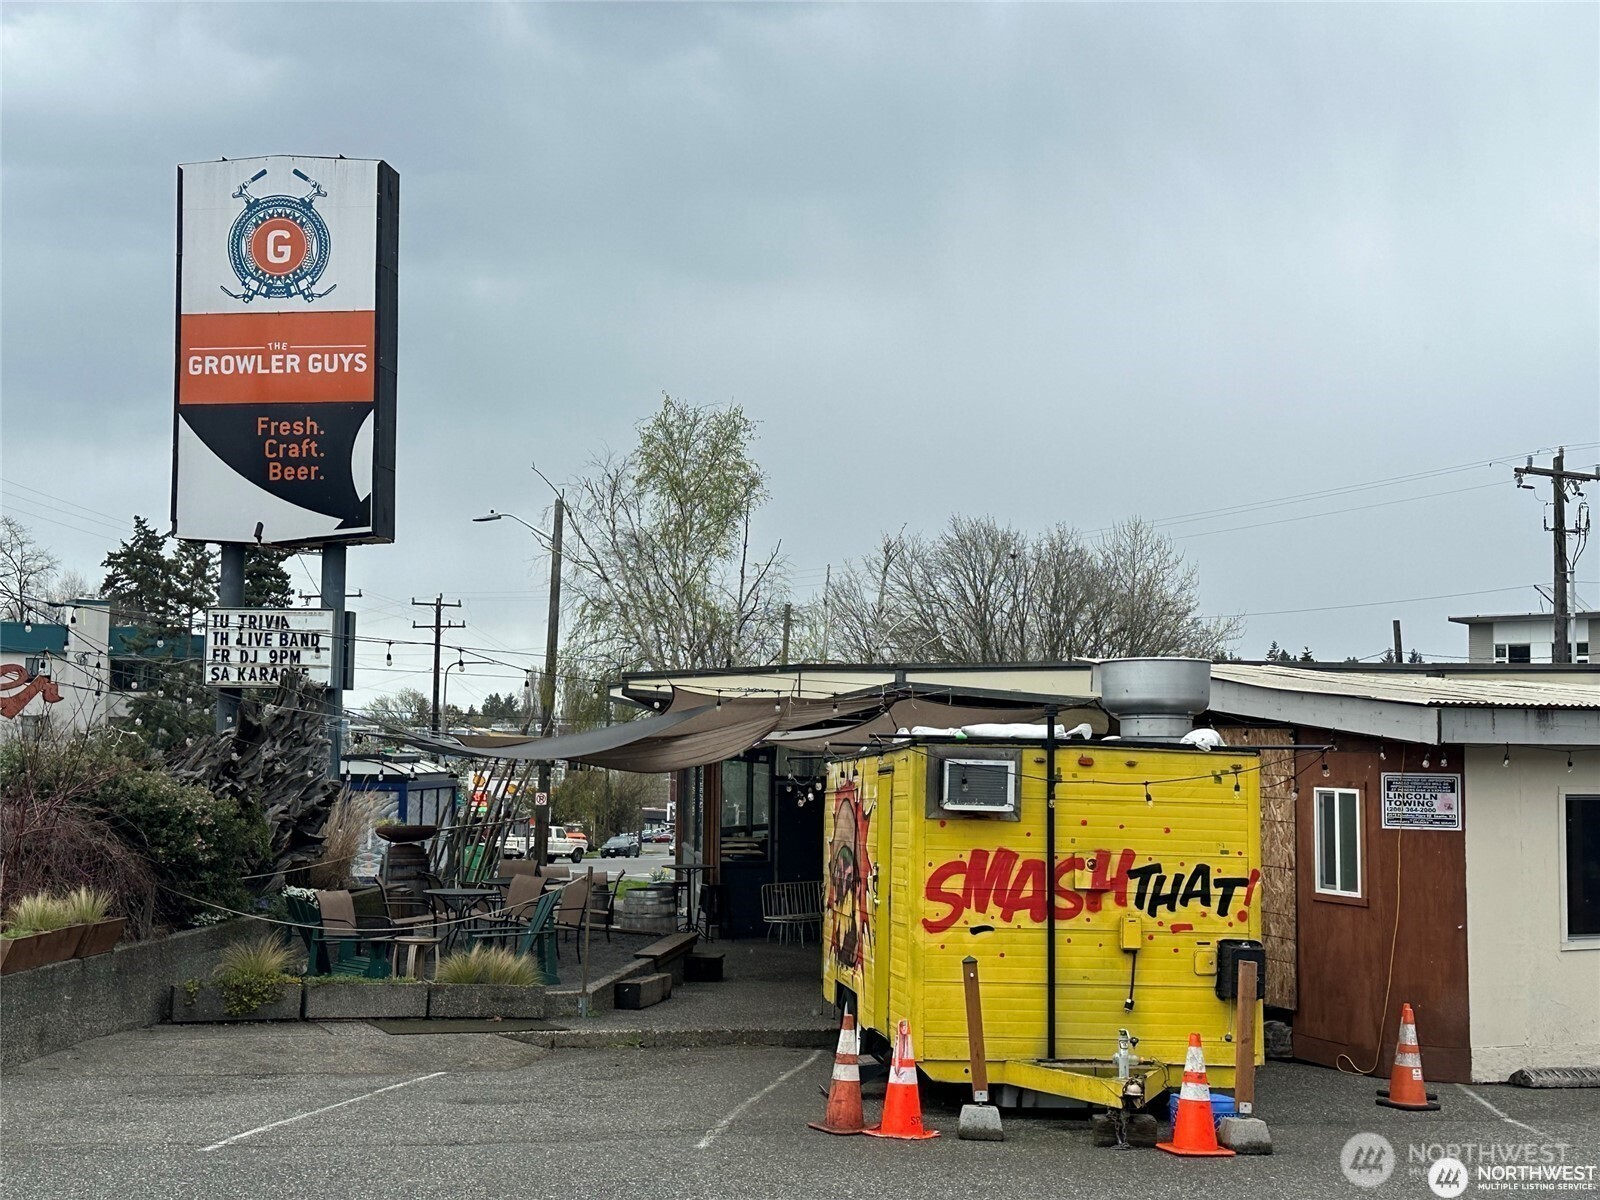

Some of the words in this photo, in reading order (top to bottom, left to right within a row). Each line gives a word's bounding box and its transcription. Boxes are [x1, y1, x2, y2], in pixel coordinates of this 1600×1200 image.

[267, 230, 292, 263] G
[268, 342, 288, 351] THE
[188, 354, 300, 375] GROWLER
[308, 353, 367, 373] GUYS
[257, 417, 325, 436] Fresh.
[264, 439, 325, 458] Craft.
[268, 462, 325, 481] Beer.
[212, 614, 229, 628] TU
[238, 614, 290, 629] TRIVIA
[213, 632, 229, 646] TH
[239, 632, 273, 647] LIVE
[279, 633, 320, 647] BAND
[212, 649, 230, 663] FR
[240, 650, 258, 664] DJ
[269, 650, 301, 664] 9PM
[211, 667, 230, 681] SA
[922, 848, 1136, 934] SMASH
[1128, 864, 1260, 923] THAT!
